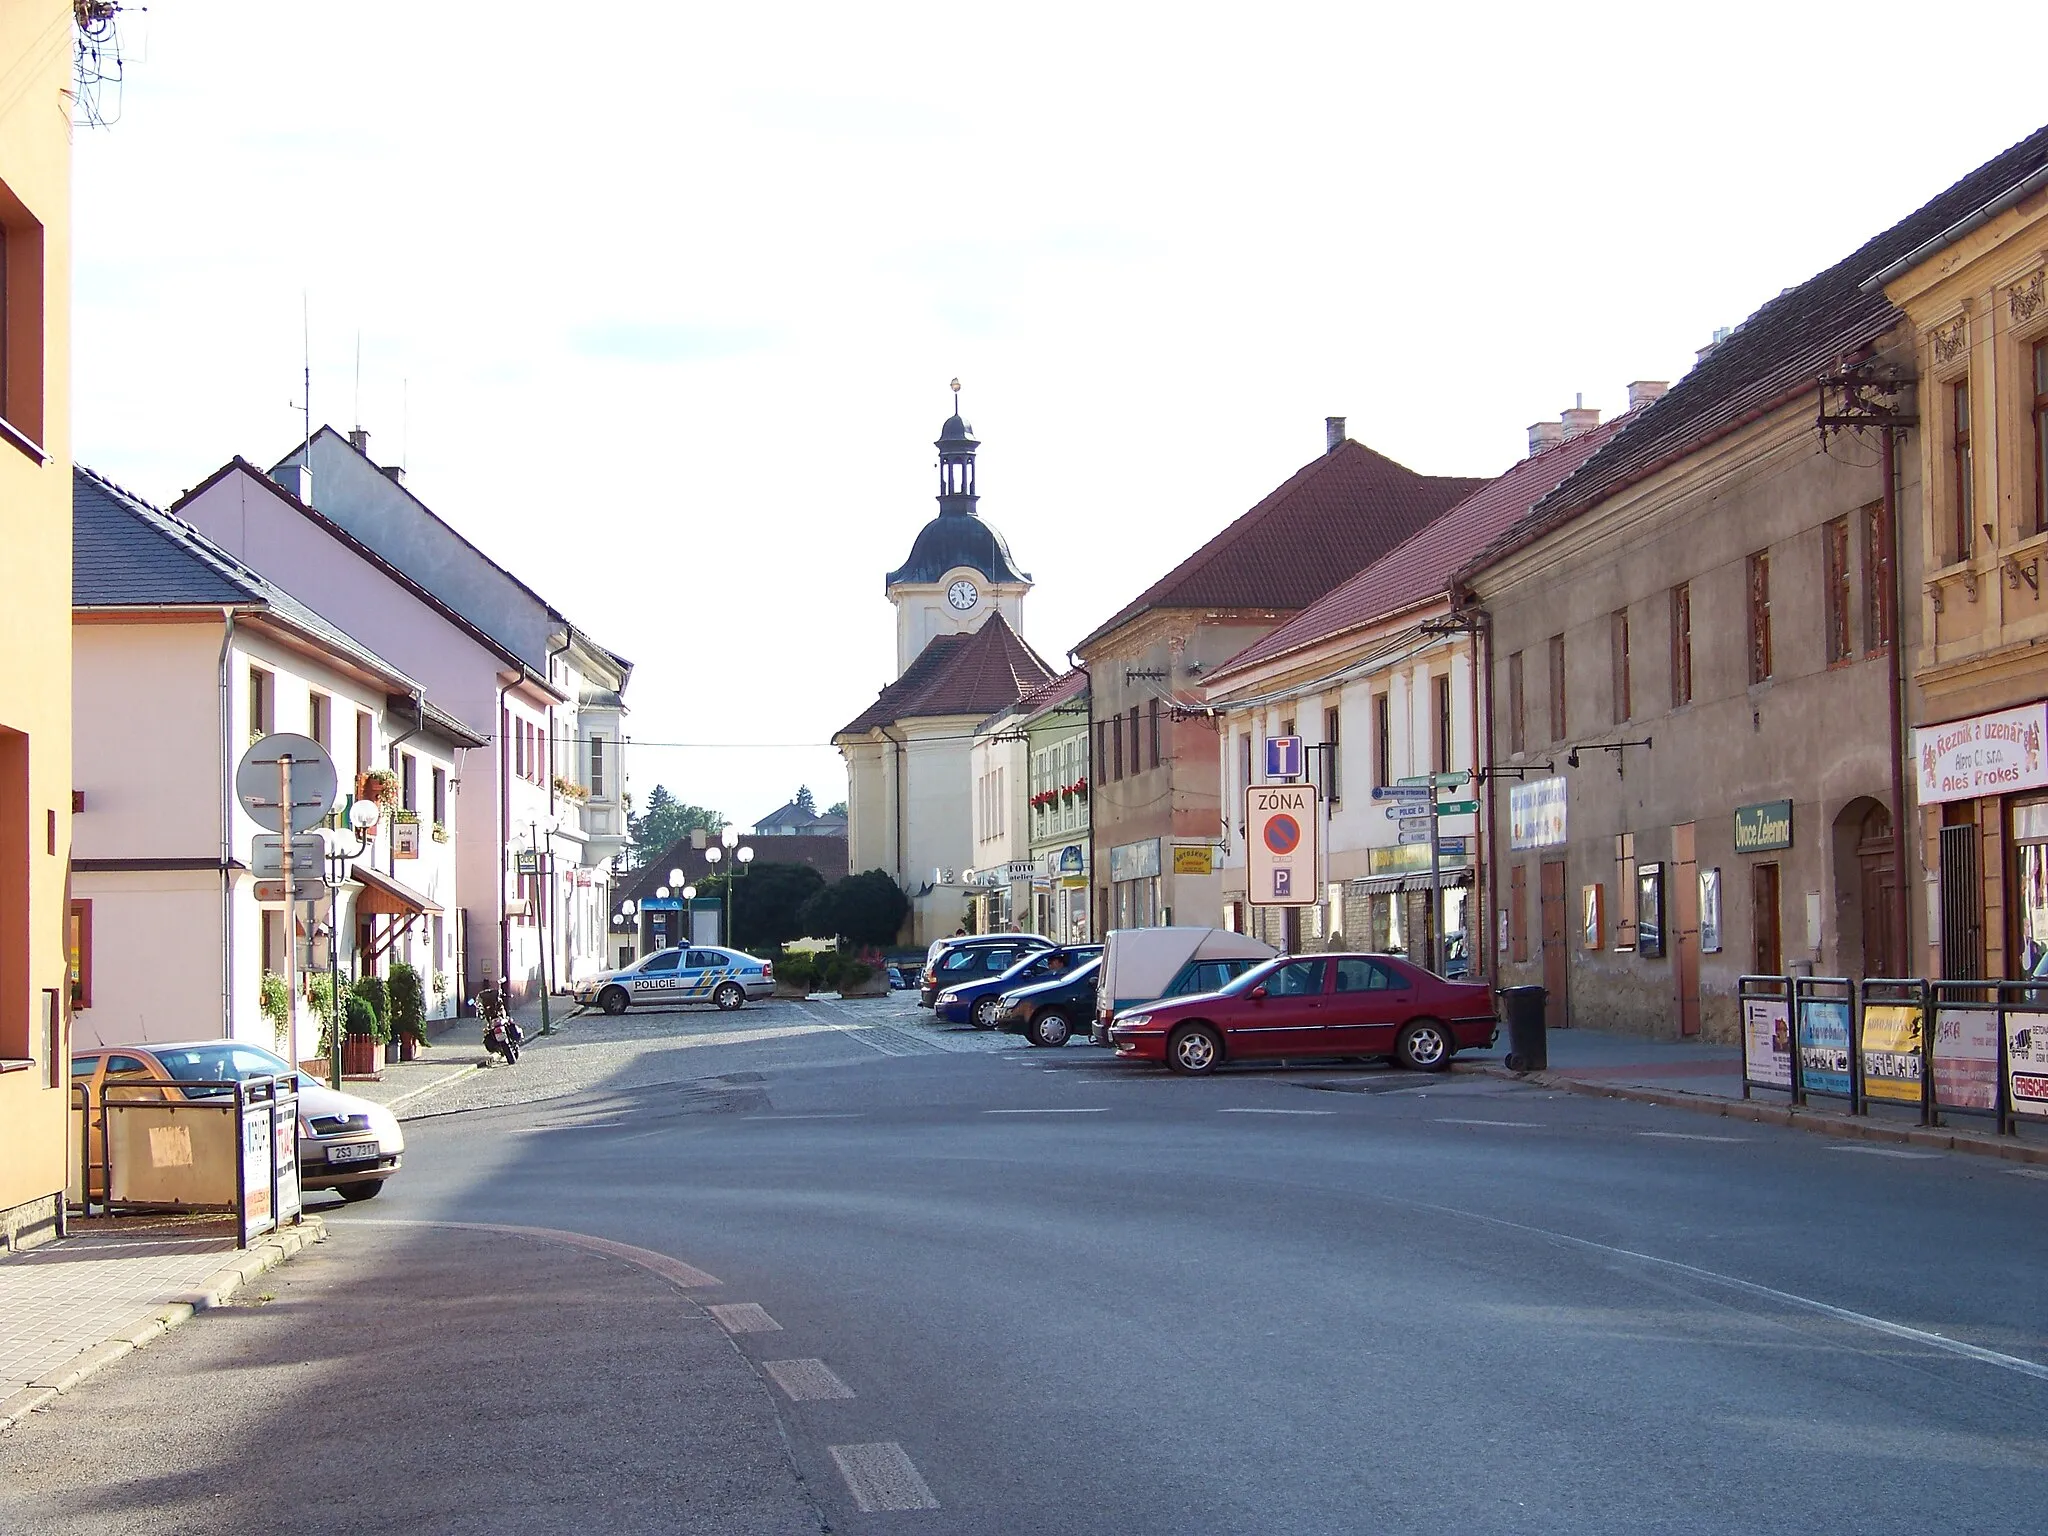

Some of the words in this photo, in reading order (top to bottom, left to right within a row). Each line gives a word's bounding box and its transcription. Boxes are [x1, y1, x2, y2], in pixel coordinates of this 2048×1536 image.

[1942, 772, 1969, 792] Aleš
[1975, 762, 2019, 786] Prokeš
[1258, 790, 1305, 810] ZÓNA
[1399, 807, 1416, 816] POLICIE
[1736, 813, 1757, 847] Ovoce
[1757, 809, 1789, 845] Zelenina
[1009, 863, 1034, 873] FOTO
[1009, 873, 1034, 881] atelier
[1276, 871, 1288, 889] P
[634, 979, 676, 989] POLICIE
[335, 1146, 352, 1158] 2S3
[356, 1144, 376, 1156] 7317
